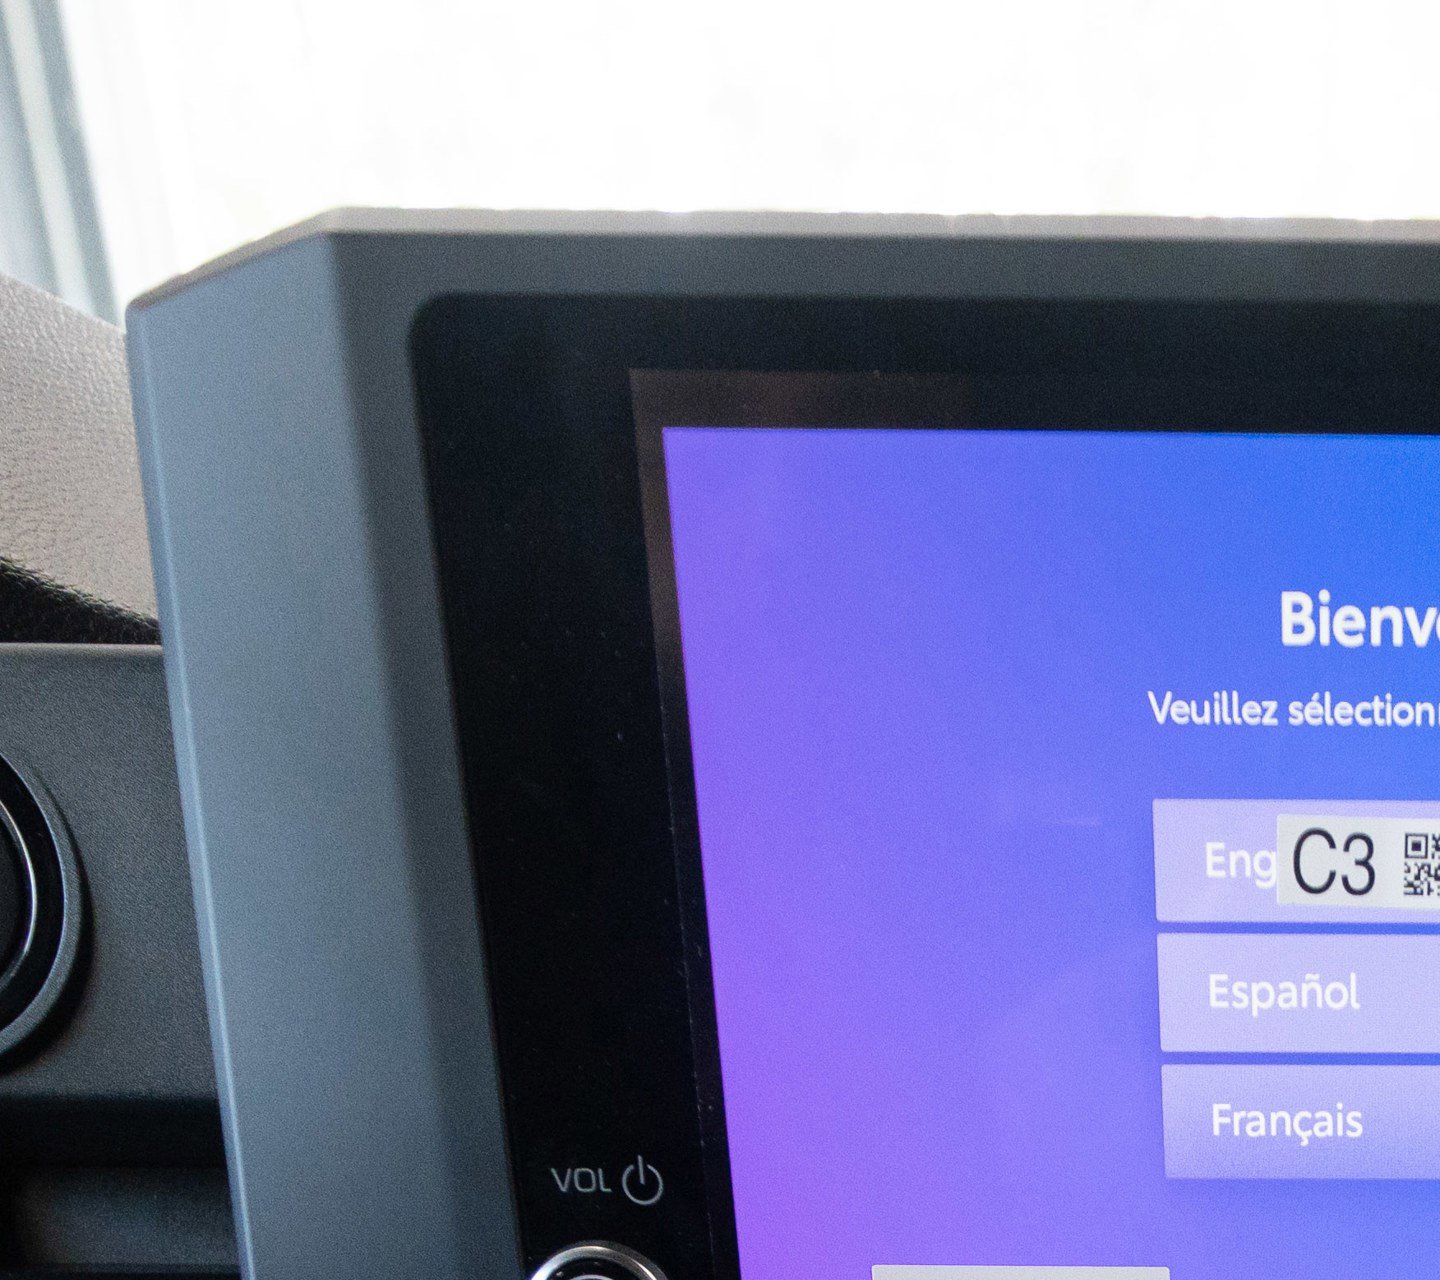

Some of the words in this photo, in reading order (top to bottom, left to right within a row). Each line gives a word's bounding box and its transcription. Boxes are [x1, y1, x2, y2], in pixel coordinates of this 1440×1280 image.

[1148, 691, 1278, 726] Veuillez
[1293, 827, 1376, 897] C3
[1208, 972, 1361, 1017] Español
[1211, 1102, 1363, 1146] Français
[550, 1168, 612, 1194] VOL
